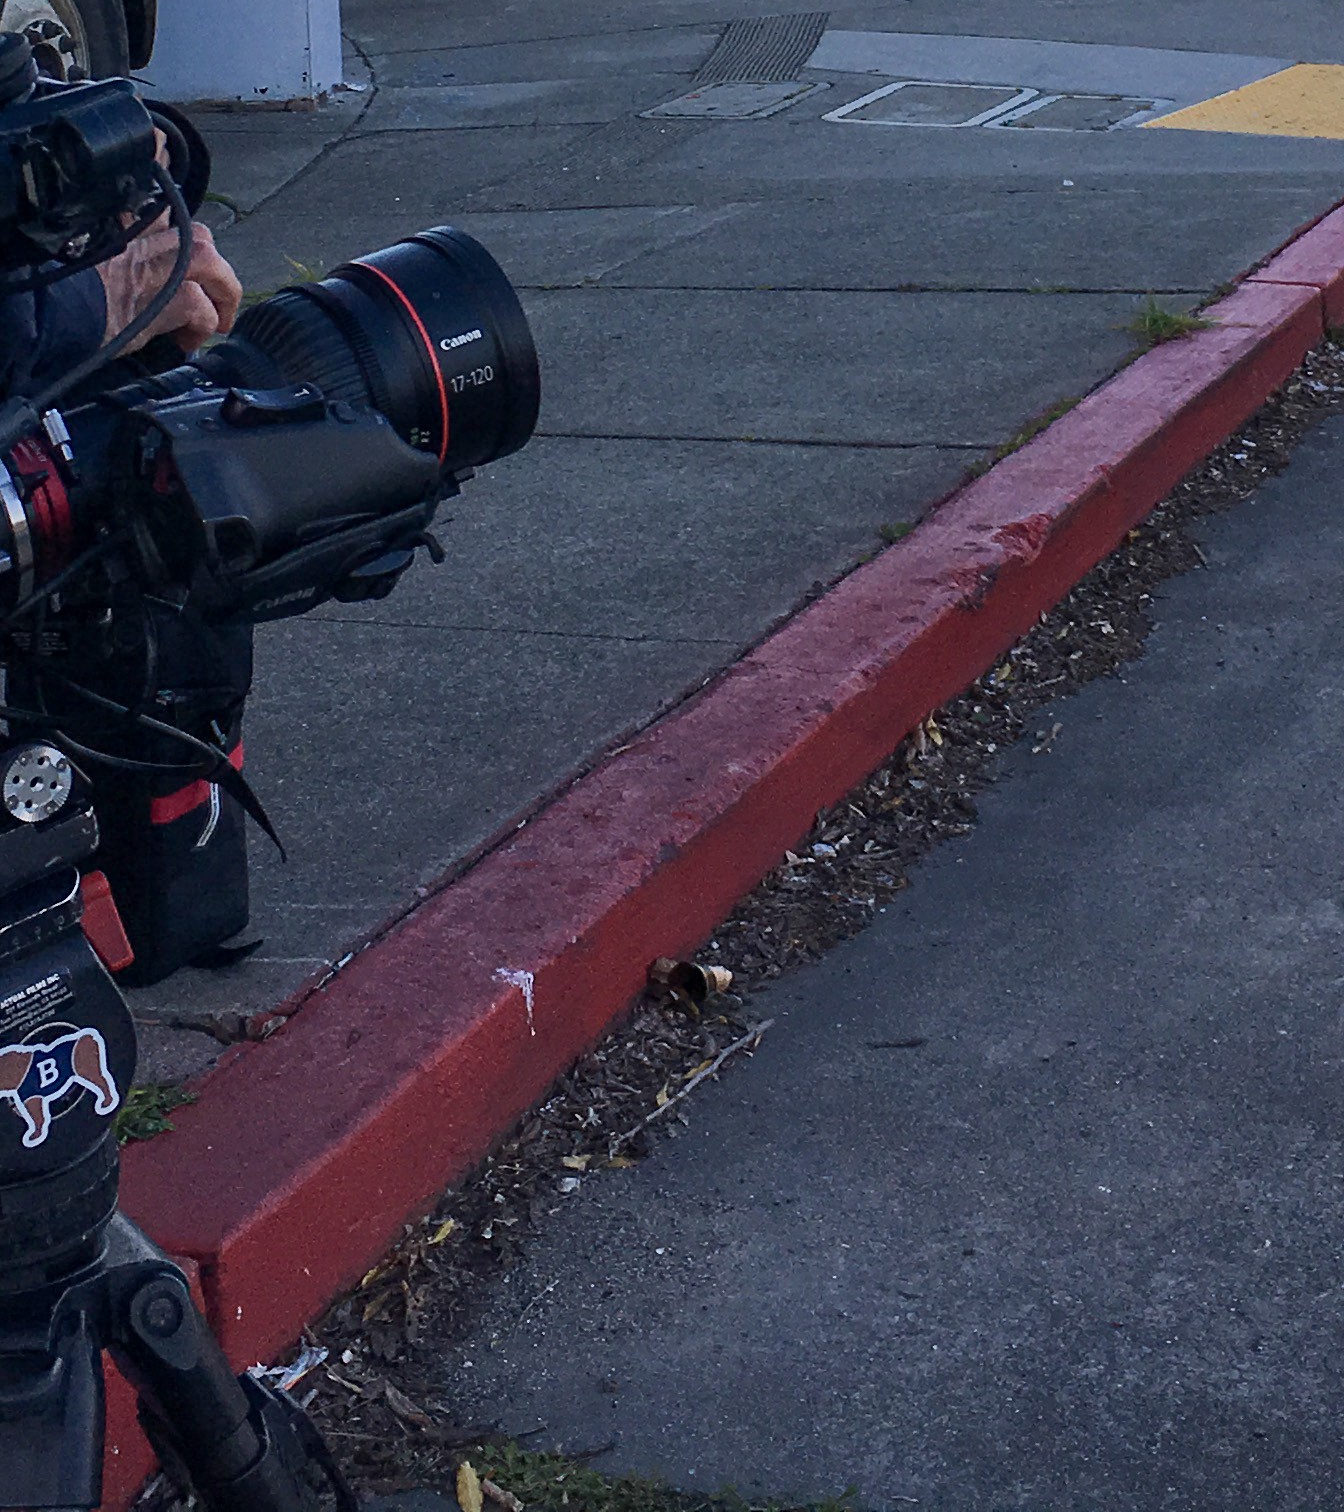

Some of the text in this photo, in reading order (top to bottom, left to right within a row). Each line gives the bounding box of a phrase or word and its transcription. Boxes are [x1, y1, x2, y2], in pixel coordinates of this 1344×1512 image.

[440, 327, 482, 351] Canon
[450, 365, 494, 393] 17-120
[0, 973, 60, 1009] ACTUAL FILMS INC
[37, 1057, 59, 1088] B
